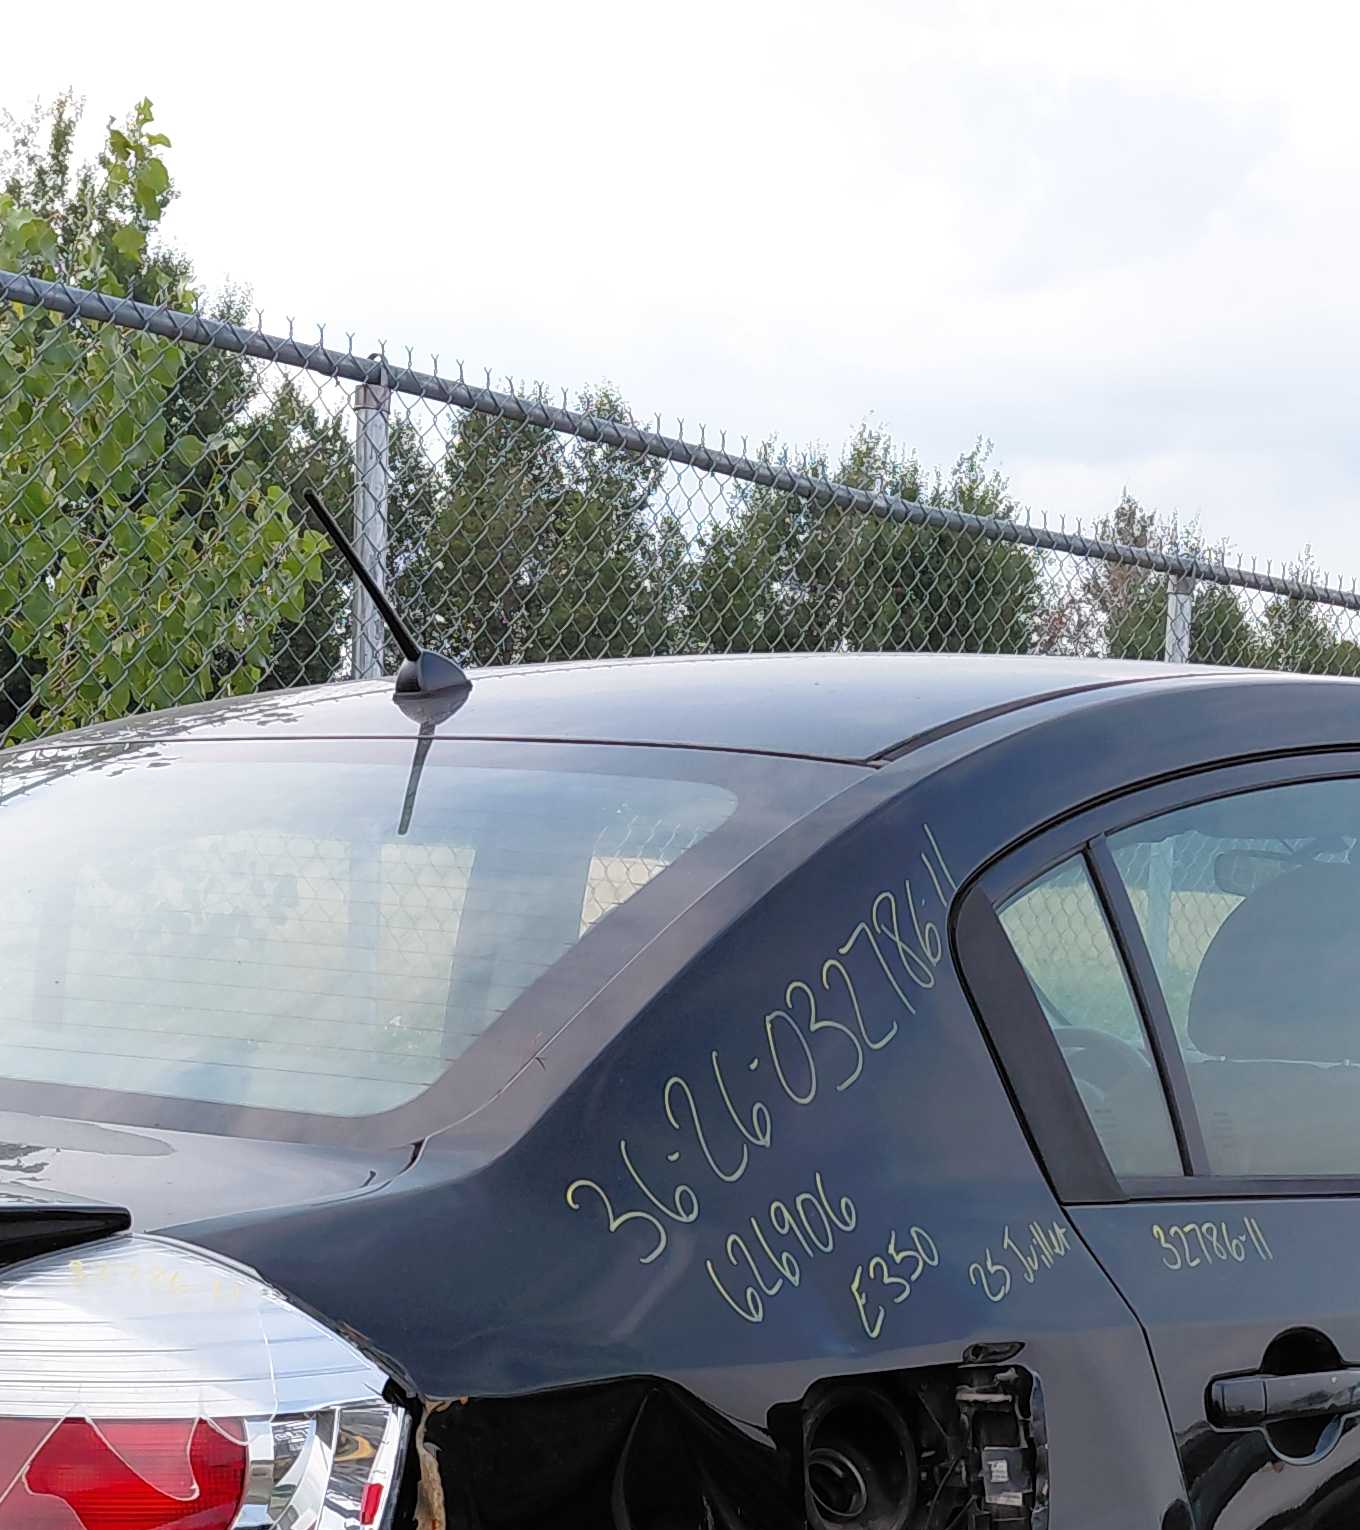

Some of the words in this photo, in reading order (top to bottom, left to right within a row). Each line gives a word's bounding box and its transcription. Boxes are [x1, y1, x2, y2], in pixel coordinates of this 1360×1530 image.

[707, 1172, 857, 1323] 626906
[850, 1226, 939, 1338] E350
[969, 1248, 1011, 1301] 25
